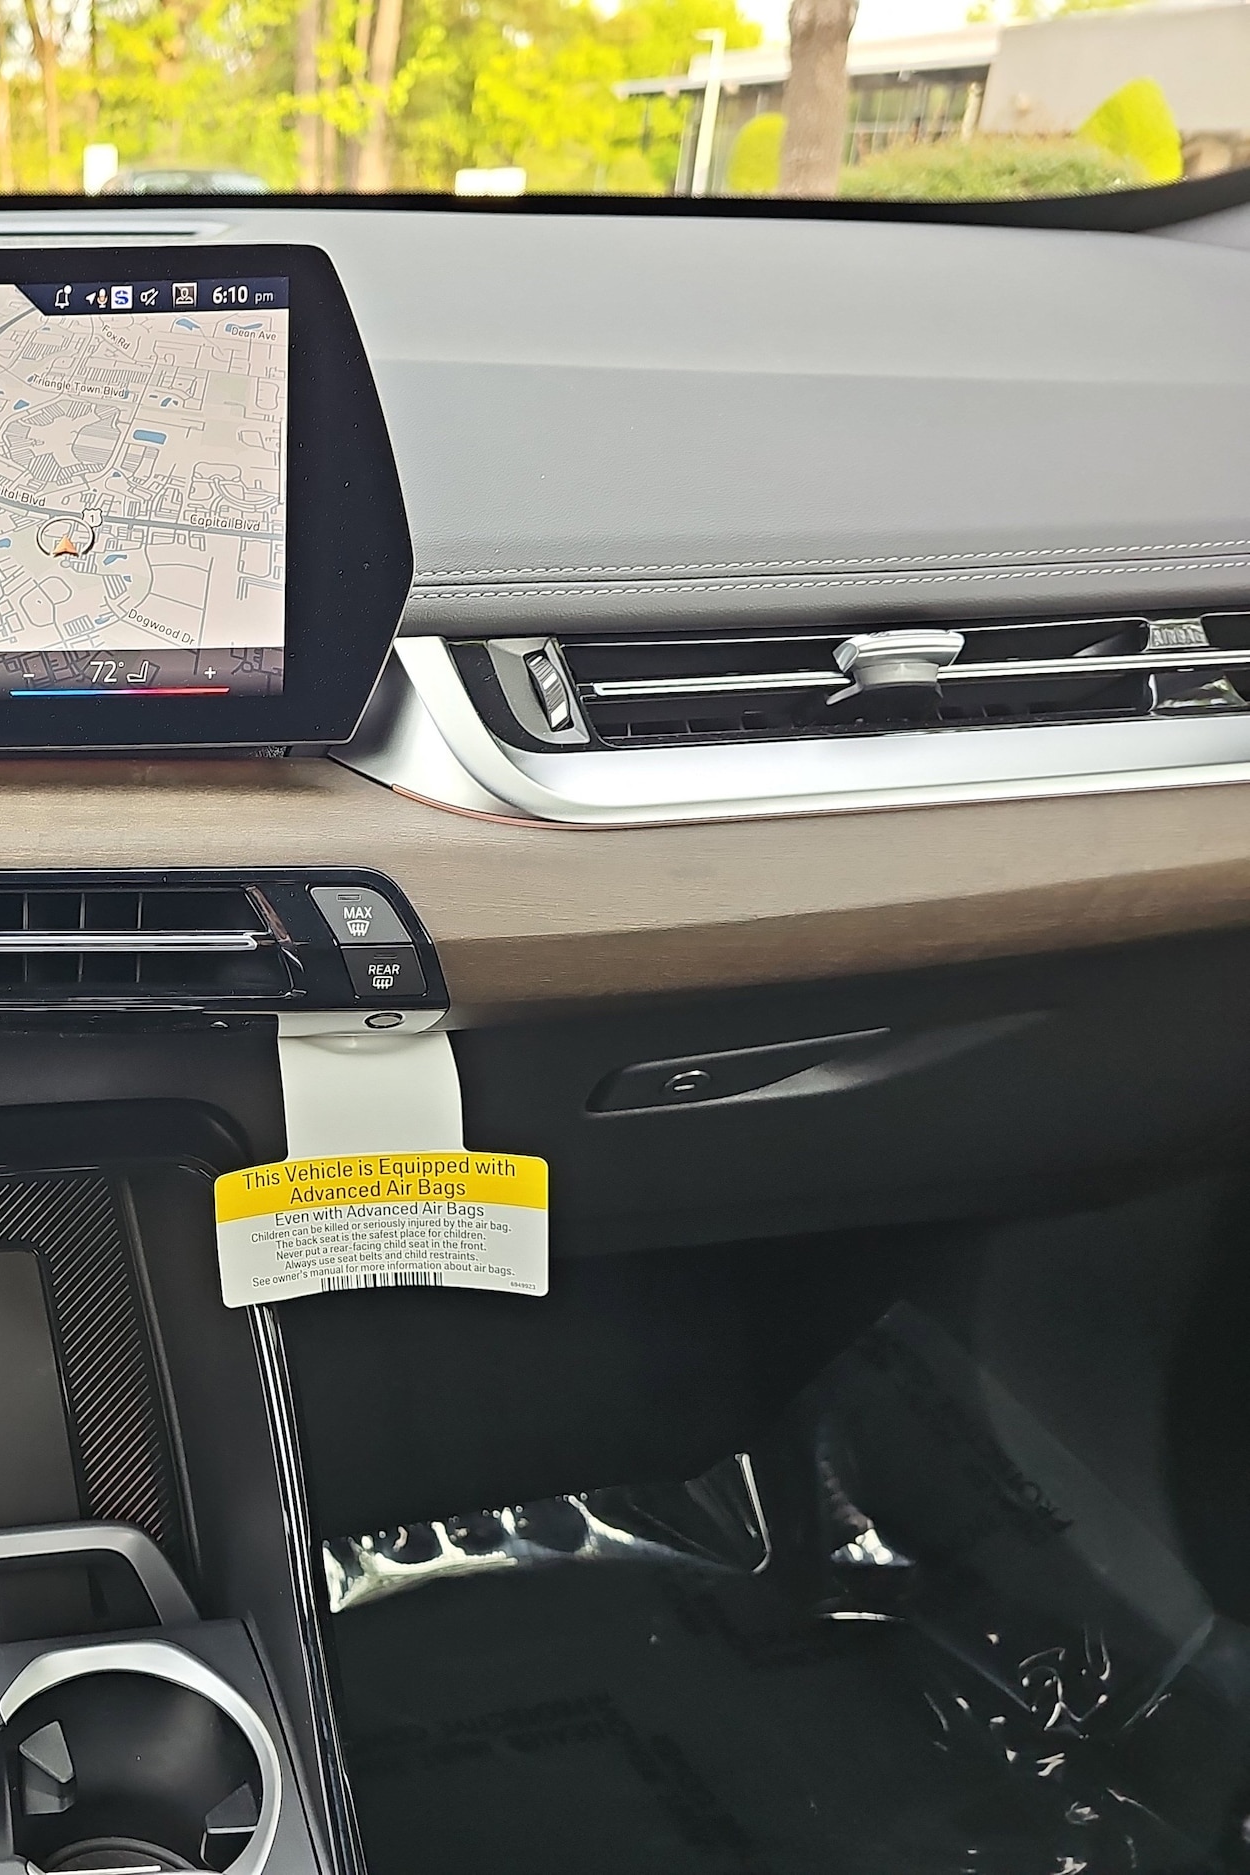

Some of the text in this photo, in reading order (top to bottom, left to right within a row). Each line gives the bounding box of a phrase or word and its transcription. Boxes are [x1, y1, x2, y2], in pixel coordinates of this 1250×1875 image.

[212, 286, 274, 305] 6:10 pm
[102, 324, 131, 350] Fox Rd
[231, 326, 277, 341] Dean Ave
[33, 373, 125, 398] Triangle Town Blvd
[21, 492, 46, 507] Blvd
[190, 513, 261, 532] Capital Blvd
[128, 608, 195, 645] Dogwood Dr
[89, 660, 125, 683] 72°
[343, 906, 373, 919] MAX
[367, 964, 401, 976] REAR
[242, 1157, 516, 1190] This Vehicle is Equipped with
[290, 1178, 466, 1205] Advanced Air Bags
[275, 1201, 485, 1227] Even with Advanced Air Bags
[251, 1218, 512, 1243] Children can be killed or seriously injured by the air bag.
[275, 1228, 487, 1250] The back seat is the safest place for children.
[276, 1239, 487, 1260] Never put a rear-facing child seat in the front.
[284, 1249, 479, 1271] Always use seat belts and child restraints.
[252, 1260, 516, 1288] See owner's manual for more information about air bags.
